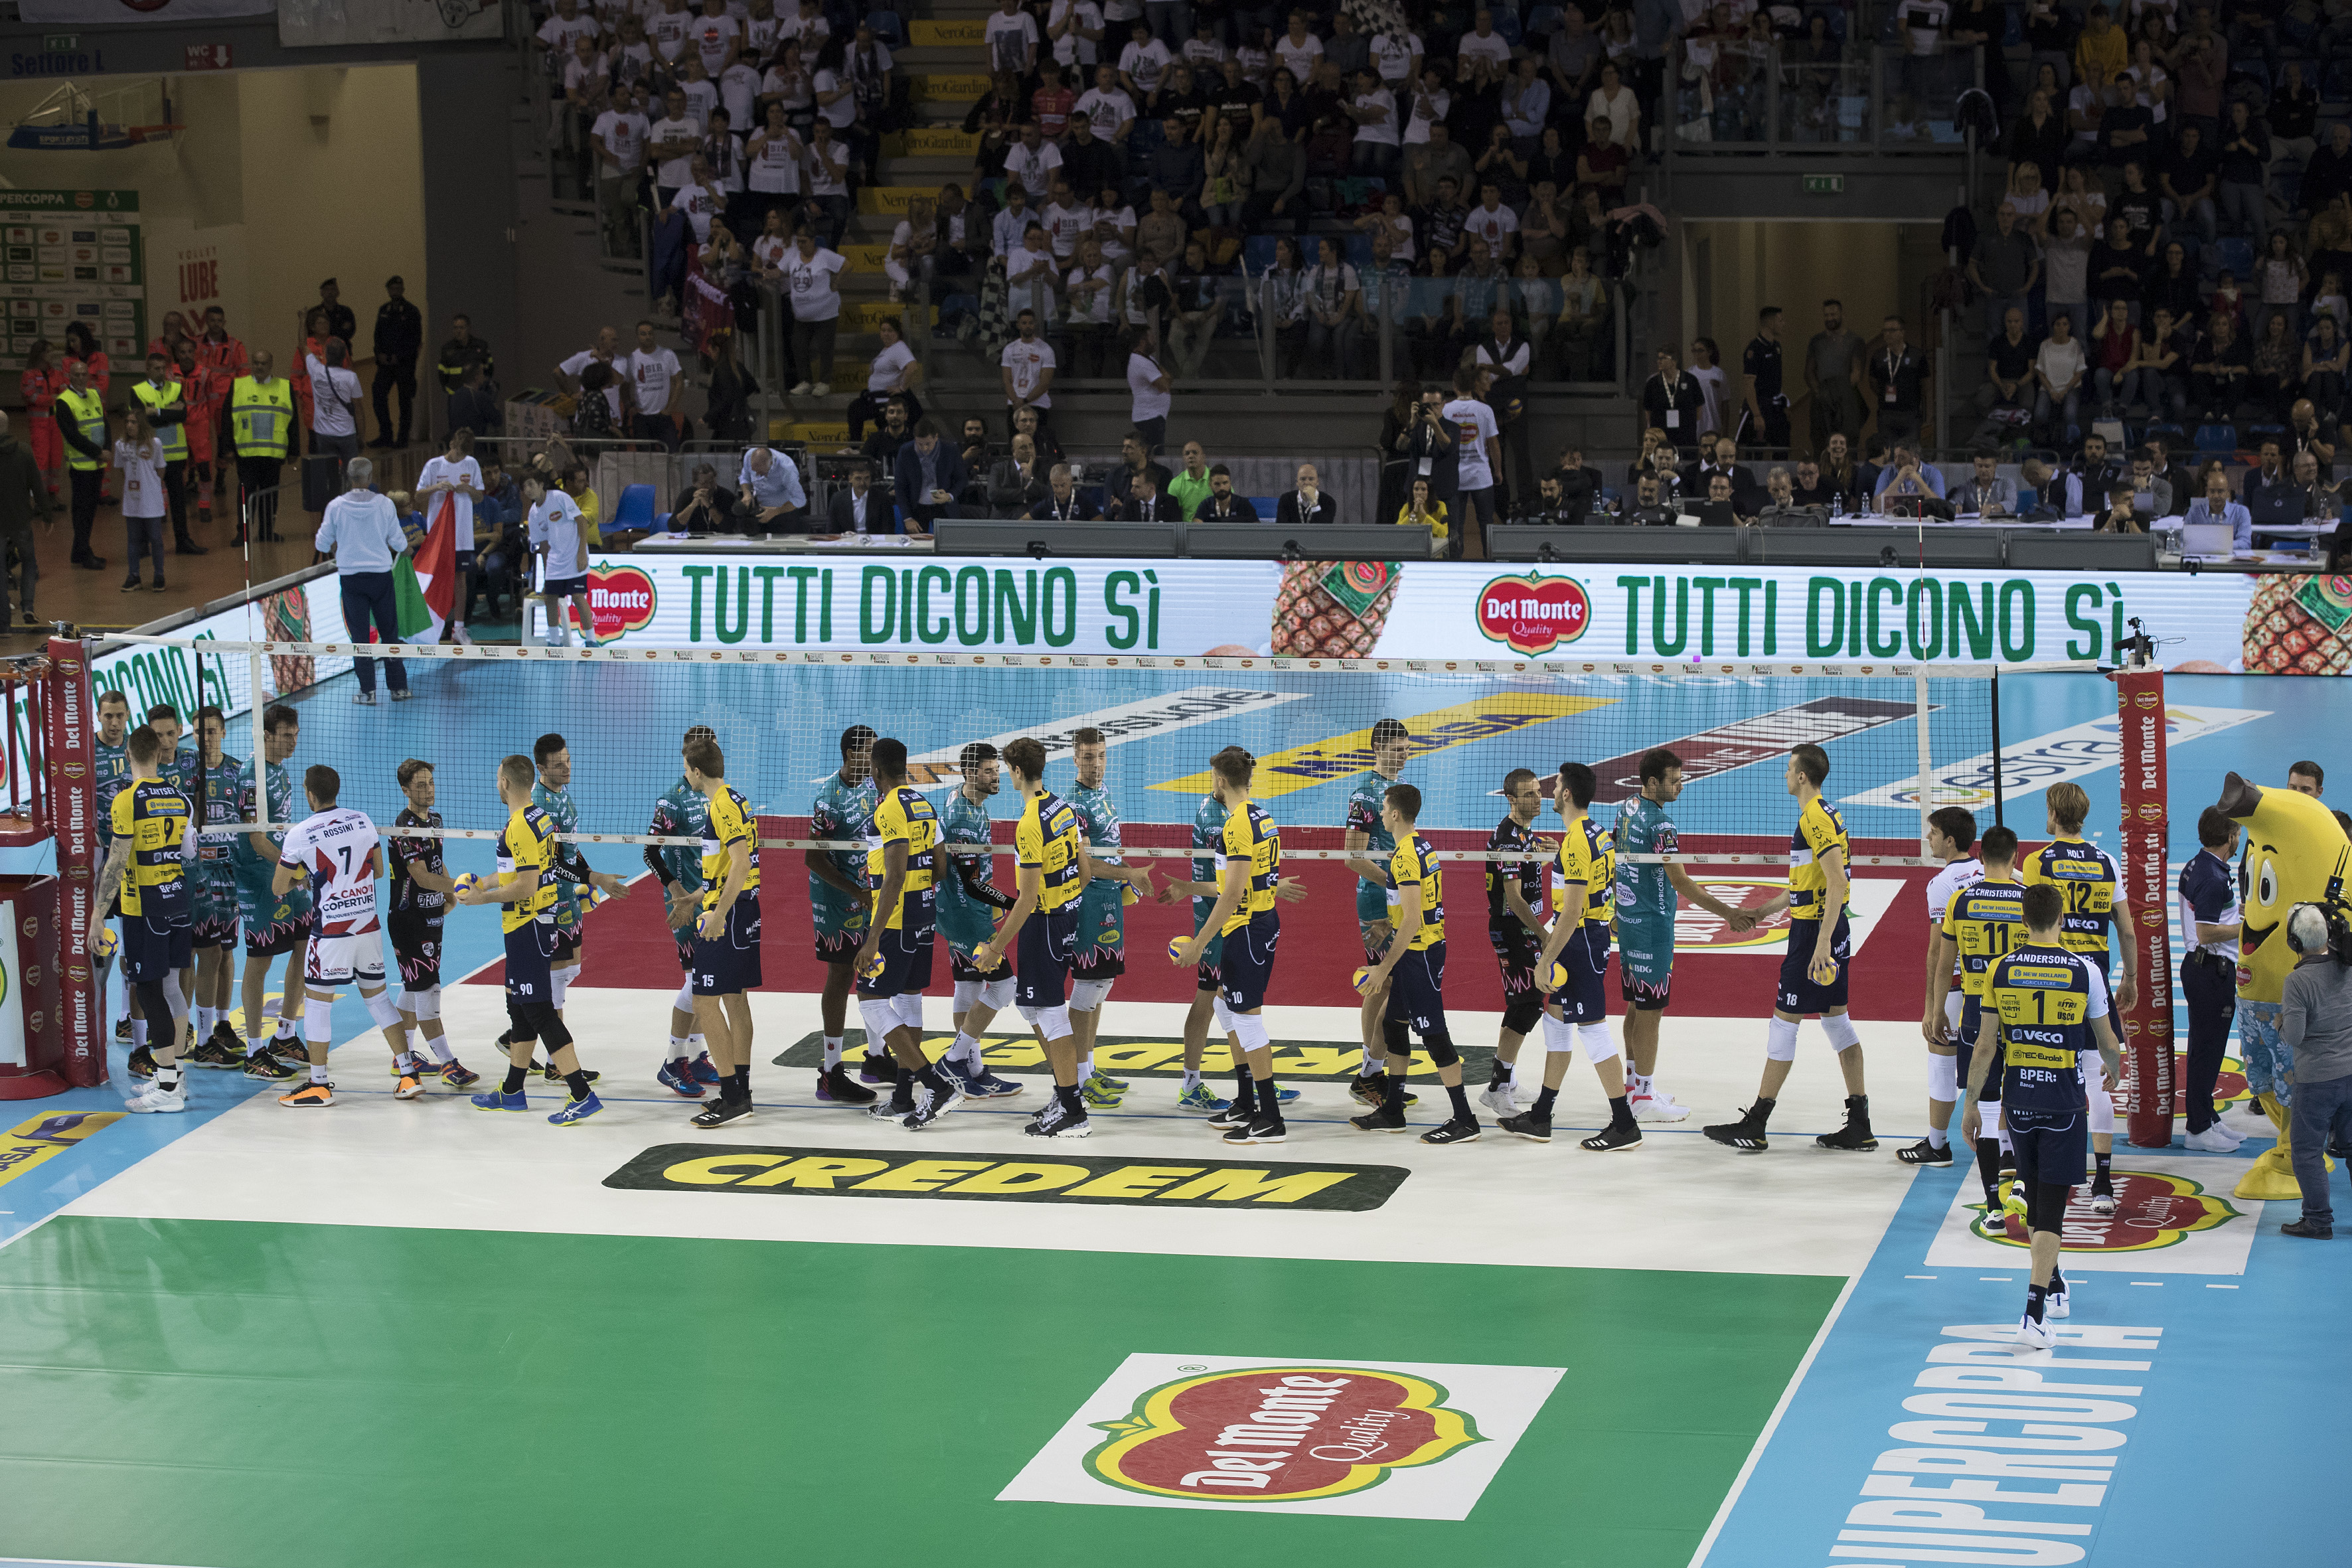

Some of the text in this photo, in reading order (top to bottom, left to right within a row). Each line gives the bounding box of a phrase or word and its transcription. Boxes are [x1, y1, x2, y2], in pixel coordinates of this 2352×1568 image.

[187, 45, 209, 56] WC
[179, 260, 219, 303] LUBE
[590, 588, 649, 609] Monte
[682, 565, 1160, 650] TUTTI DICONO SÌ
[1487, 597, 1581, 621] Del Monte
[1512, 621, 1553, 637] Quality
[1616, 576, 2124, 665] TUTTI DICONO SÌ
[65, 681, 80, 749] Del Monte
[2142, 716, 2157, 790] Del Monte
[112, 758, 124, 775] 14
[148, 787, 175, 796] ZAYTSEV
[208, 781, 217, 797] 6
[69, 787, 85, 855] Del Monte
[164, 817, 175, 843] 9
[323, 823, 354, 838] ROSSINI
[337, 845, 352, 876] 7
[2066, 849, 2085, 858] HOLT
[971, 878, 1007, 903] BALLSYSTEM
[1975, 888, 2022, 899] CHRISTENSON
[2067, 882, 2092, 913] 12
[2146, 875, 2160, 902] Del
[2093, 901, 2110, 909] USCO
[70, 887, 86, 955] Del Monte
[1983, 922, 2009, 954] 11
[1627, 950, 1654, 960] GRANIERI
[2015, 953, 2067, 965] ANDERSON
[135, 963, 141, 974] 9
[1634, 965, 1652, 974] BDG
[2151, 935, 2167, 1008] Del Monte
[520, 984, 533, 995] 90
[702, 975, 714, 987] 15
[1027, 986, 1034, 999] 5
[1231, 992, 1243, 1004] 10
[1786, 992, 1798, 1006] 18
[1577, 1002, 1584, 1015] 8
[2032, 990, 2045, 1024] 1
[2057, 1011, 2075, 1021] USCO
[74, 990, 88, 1057] Del Monte
[1417, 1016, 1430, 1028] 16
[2020, 1069, 2057, 1082] BPER:
[2156, 1044, 2169, 1116] Del Monte
[663, 1153, 1358, 1204] CREDEM
[2124, 1194, 2186, 1228] Quality
[1180, 1374, 1352, 1489] Del Monte
[1308, 1407, 1411, 1462] Quality
[1822, 1323, 2163, 1568] UPERCOPPA
